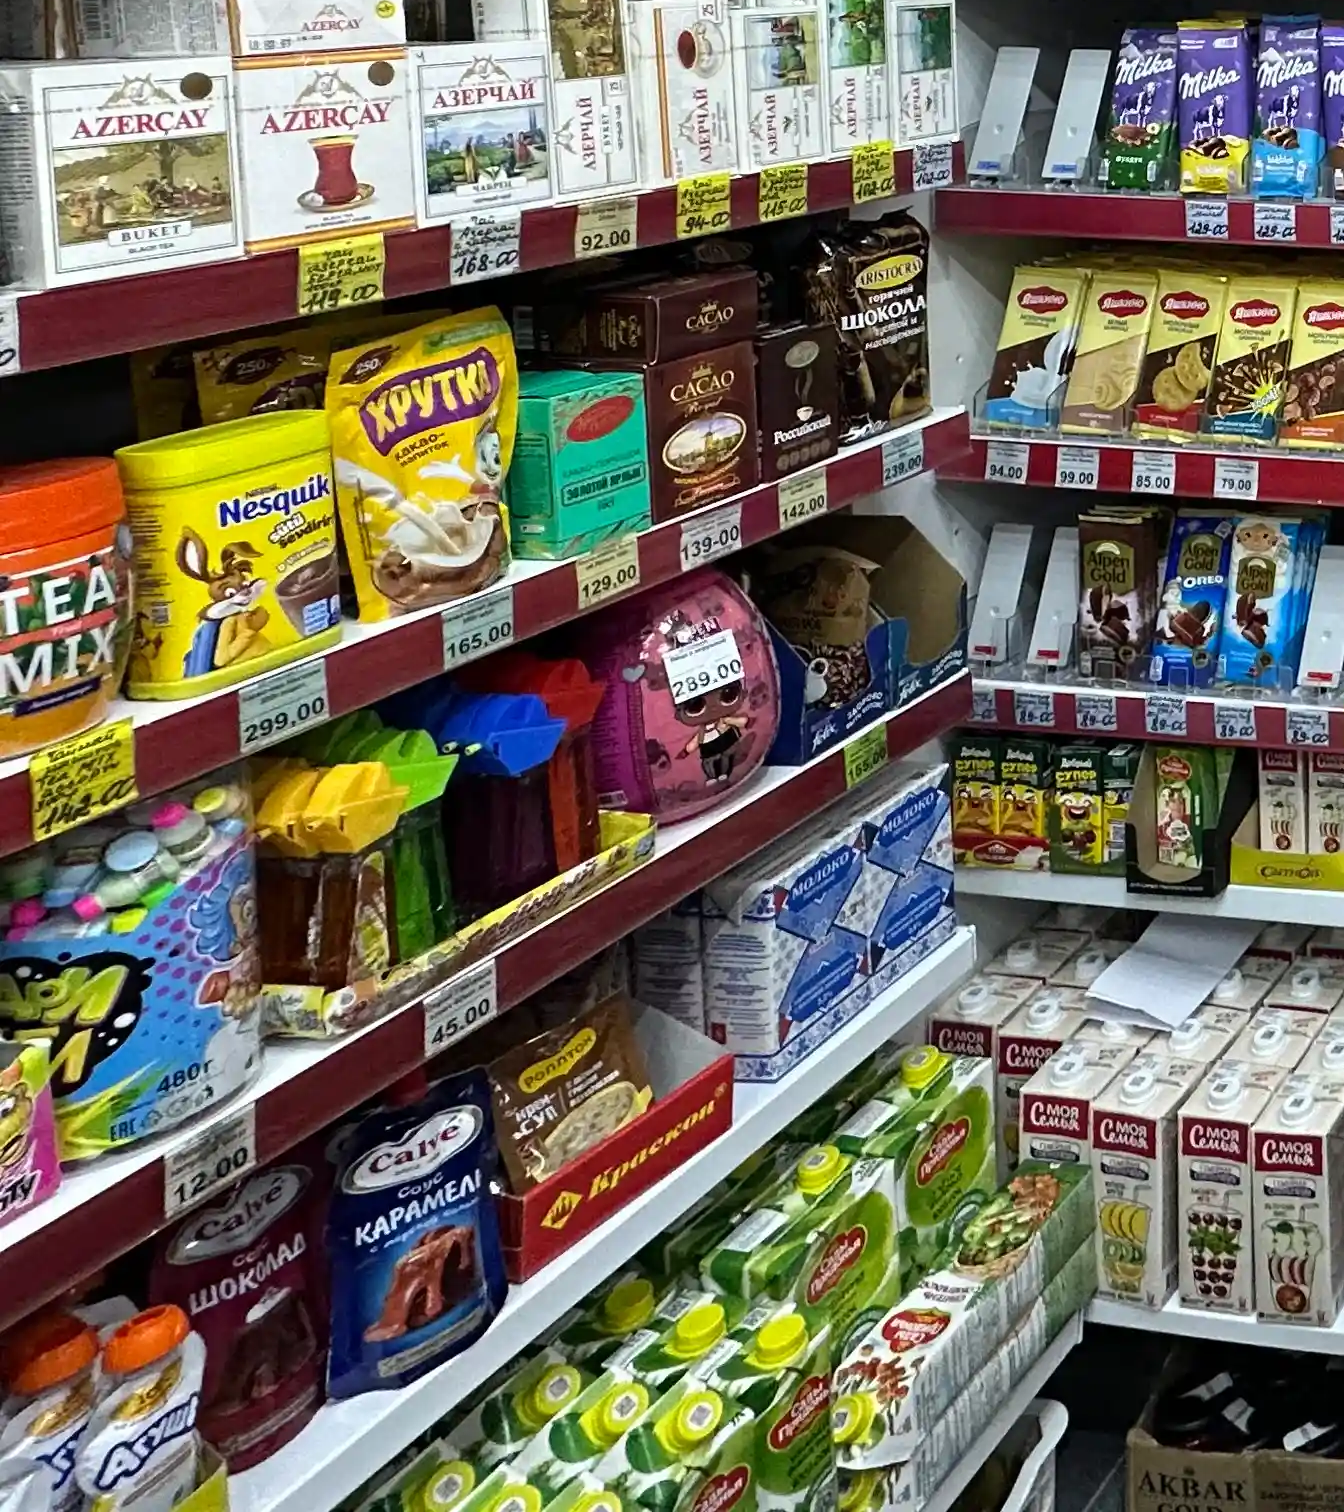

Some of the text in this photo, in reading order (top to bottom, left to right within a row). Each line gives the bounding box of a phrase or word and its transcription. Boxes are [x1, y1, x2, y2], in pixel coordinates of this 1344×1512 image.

[432, 80, 536, 109] АЗЕРЧАЙ
[1180, 70, 1241, 99] Milka
[71, 108, 210, 140] AZERÇAY
[261, 103, 391, 136] AZERÇAY
[578, 95, 594, 172] АЗЕРЧАЙ
[121, 224, 182, 242] BUKET
[581, 230, 631, 250] 92.00
[686, 305, 734, 330] CACAO
[1230, 305, 1279, 321] Яшкино
[1136, 475, 1171, 490] 85.00
[218, 474, 330, 527] Nesquik
[1086, 553, 1131, 573] Alpen
[1089, 567, 1127, 585] Gold
[1, 566, 116, 625] TEA
[1183, 574, 1224, 588] OREO
[1, 628, 116, 694] MIX
[673, 659, 742, 697] 289.00
[791, 852, 850, 895] МОЛОКО
[432, 998, 491, 1045] 45.00
[368, 1119, 461, 1178] Calvé
[1278, 1137, 1314, 1158] МОЯ
[173, 1148, 249, 1205] 12.00
[188, 1233, 307, 1315] ШОКОЛАД
[1137, 1468, 1246, 1504] AKBAR
